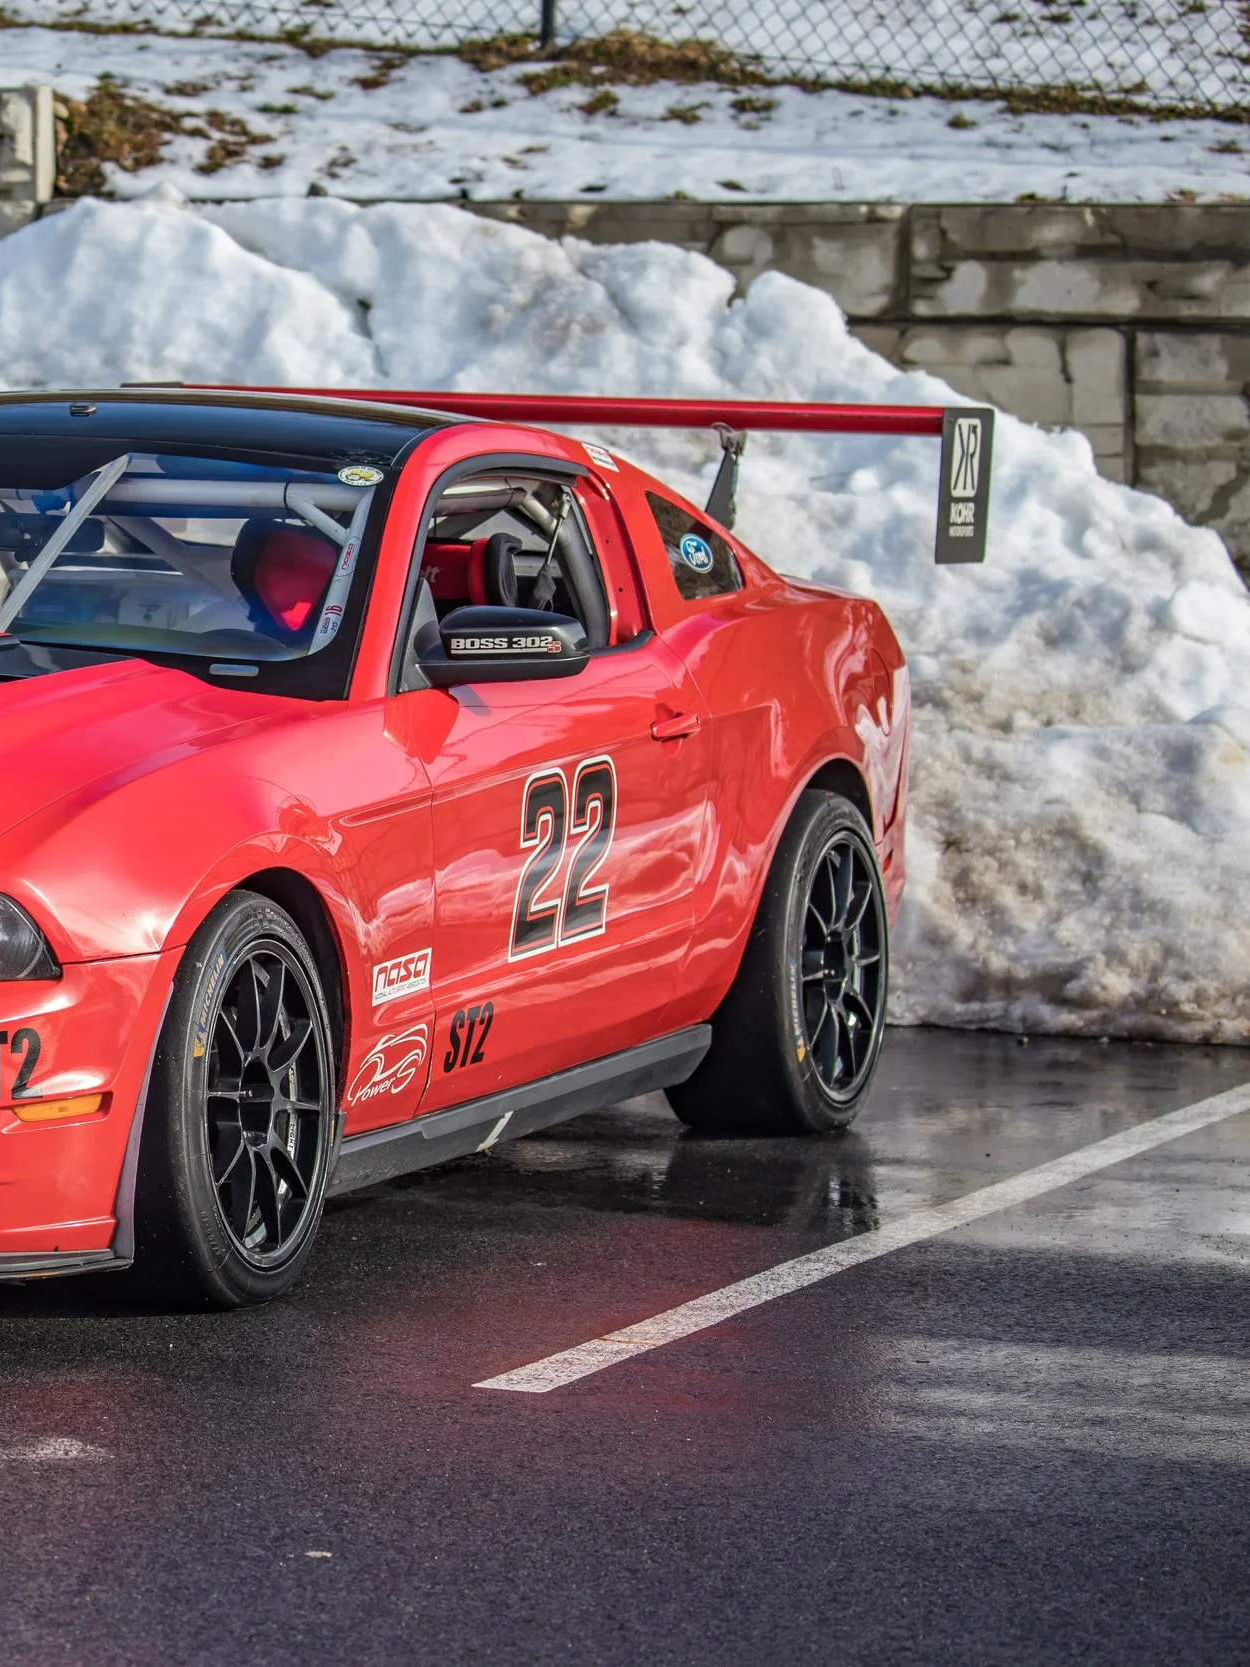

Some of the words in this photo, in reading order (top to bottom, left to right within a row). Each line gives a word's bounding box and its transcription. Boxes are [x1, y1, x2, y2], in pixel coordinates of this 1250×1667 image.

[950, 502, 975, 525] KOHR
[685, 540, 709, 566] Ford
[451, 638, 508, 650] BOSS
[507, 754, 617, 963] 22
[200, 954, 225, 1028] MICHELIN
[375, 952, 429, 992] nasa
[444, 1002, 495, 1073] ST2
